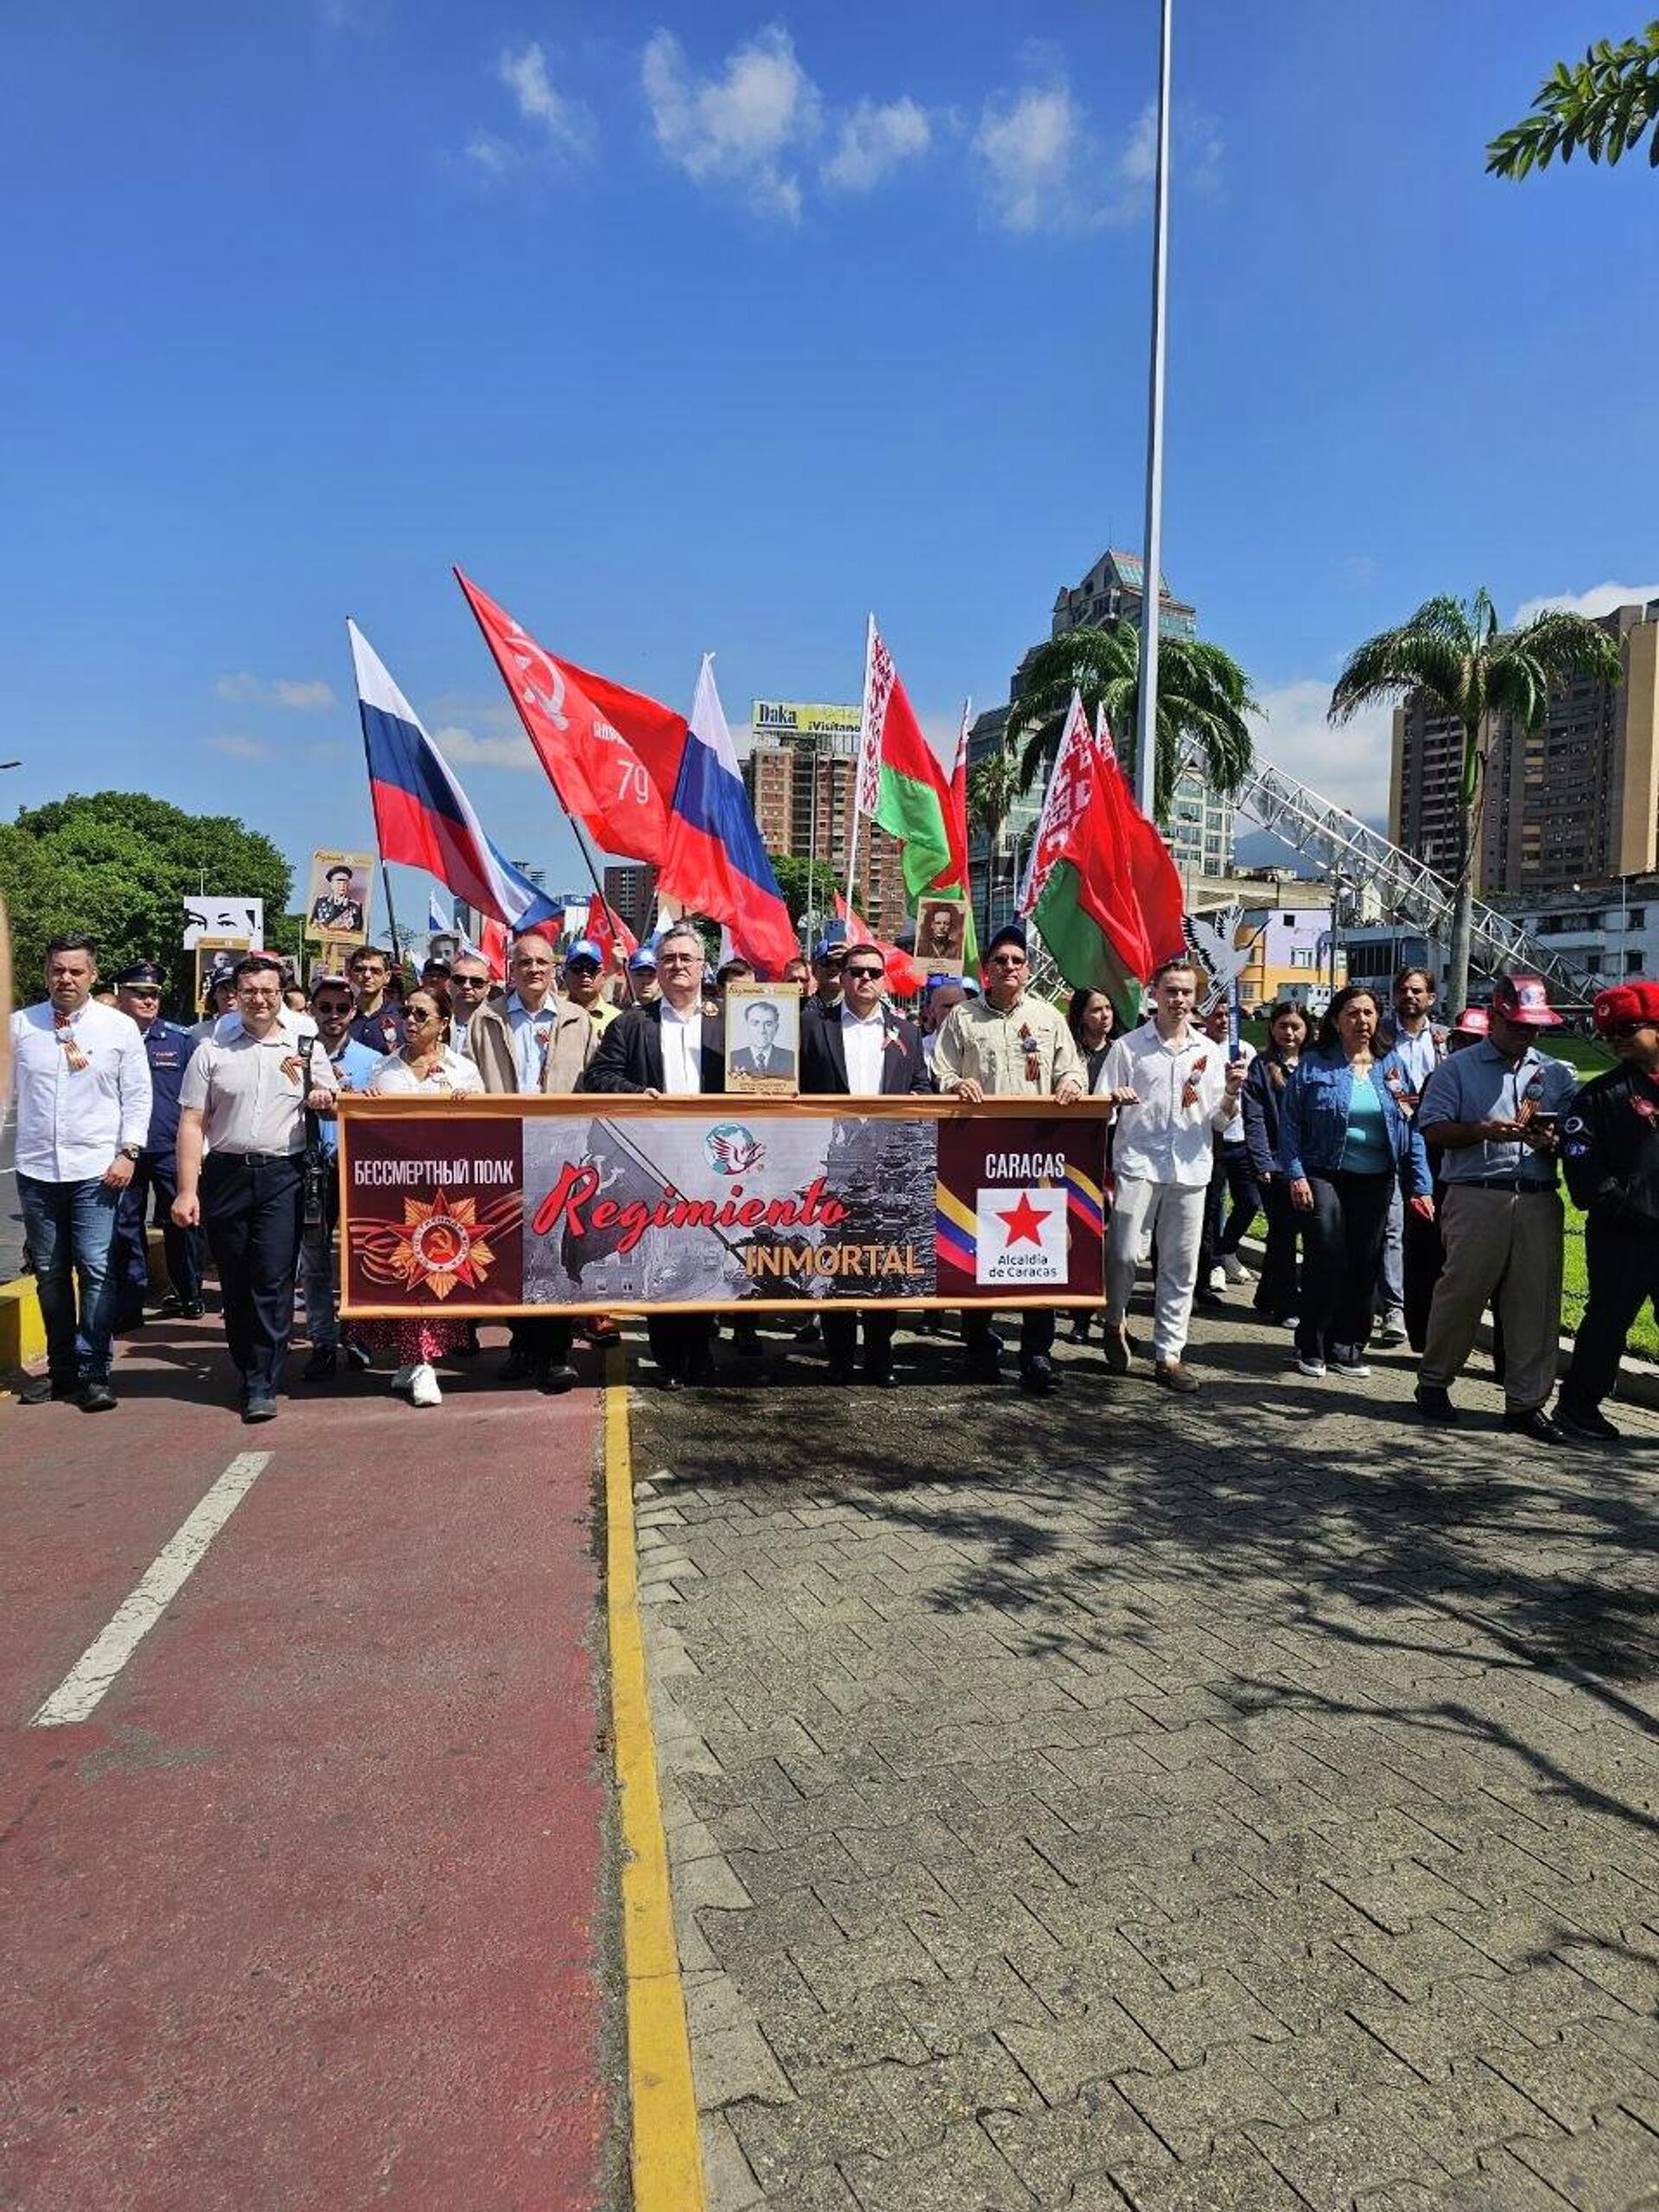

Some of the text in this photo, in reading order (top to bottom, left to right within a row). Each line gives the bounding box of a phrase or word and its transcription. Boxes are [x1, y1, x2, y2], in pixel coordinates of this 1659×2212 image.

[759, 703, 797, 723] Daka
[354, 1159, 514, 1185] БЕССМЕРТНЫЙ ПОЛК
[985, 1153, 1065, 1179] CARACAS
[531, 1161, 849, 1255] Regimiento
[745, 1244, 925, 1277] INMORTAL
[988, 1268, 1058, 1278] de Caracas
